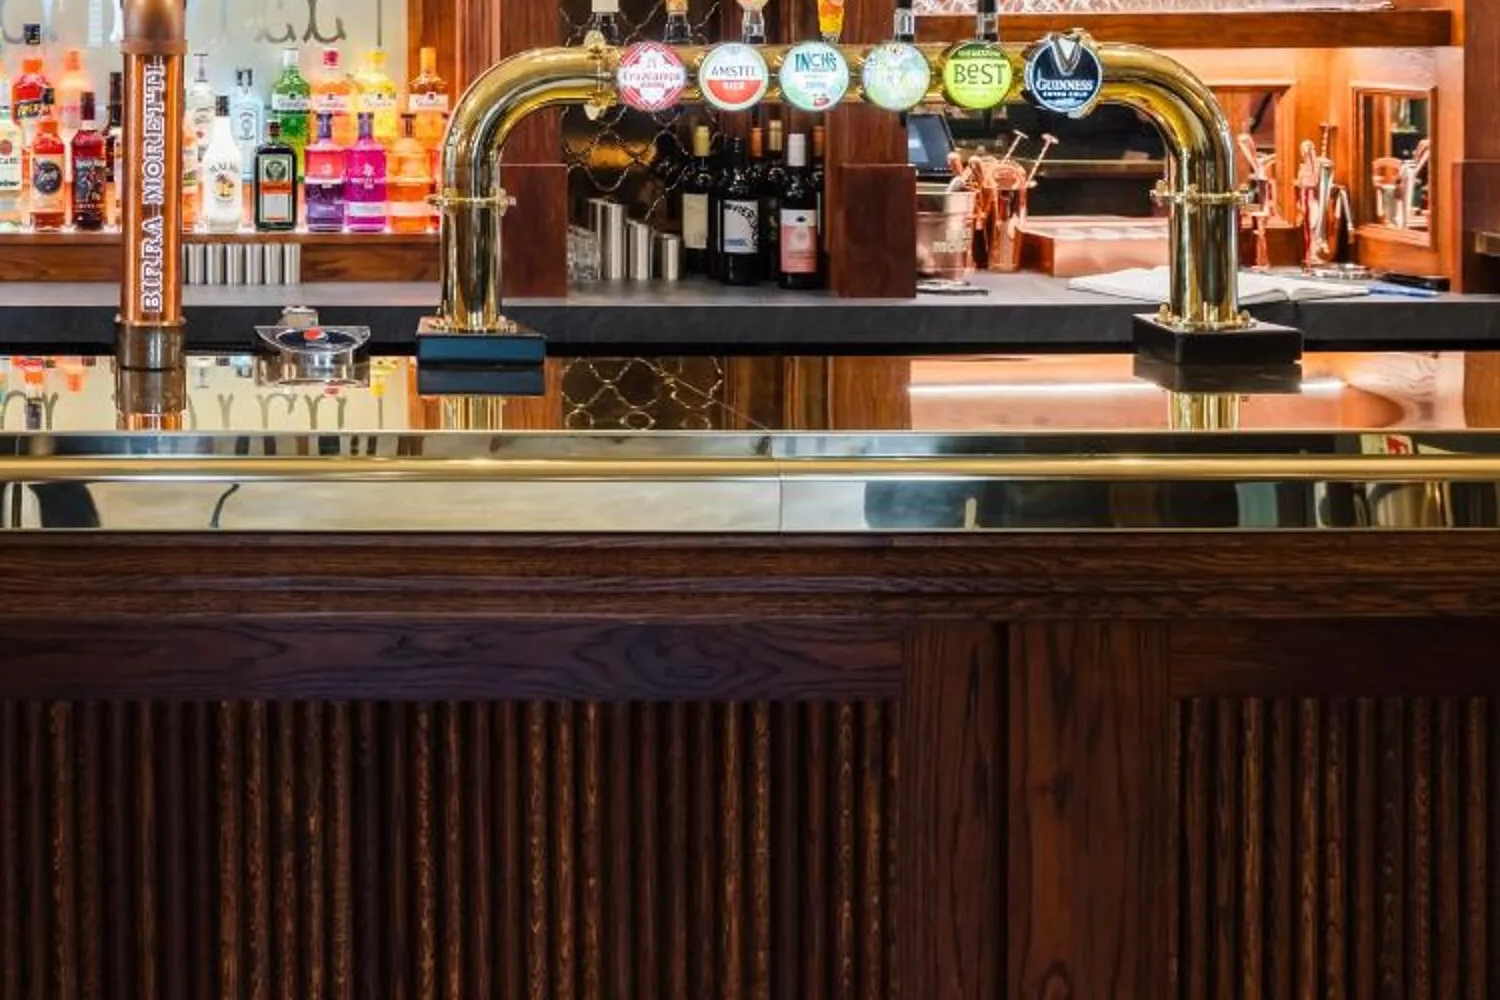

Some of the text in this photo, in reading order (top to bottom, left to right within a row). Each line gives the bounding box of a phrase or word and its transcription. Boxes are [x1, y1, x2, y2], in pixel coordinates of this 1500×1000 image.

[711, 65, 756, 77] AMSTEL
[1036, 78, 1094, 92] GUINNESS
[141, 54, 166, 314] BIRRA MORETTI
